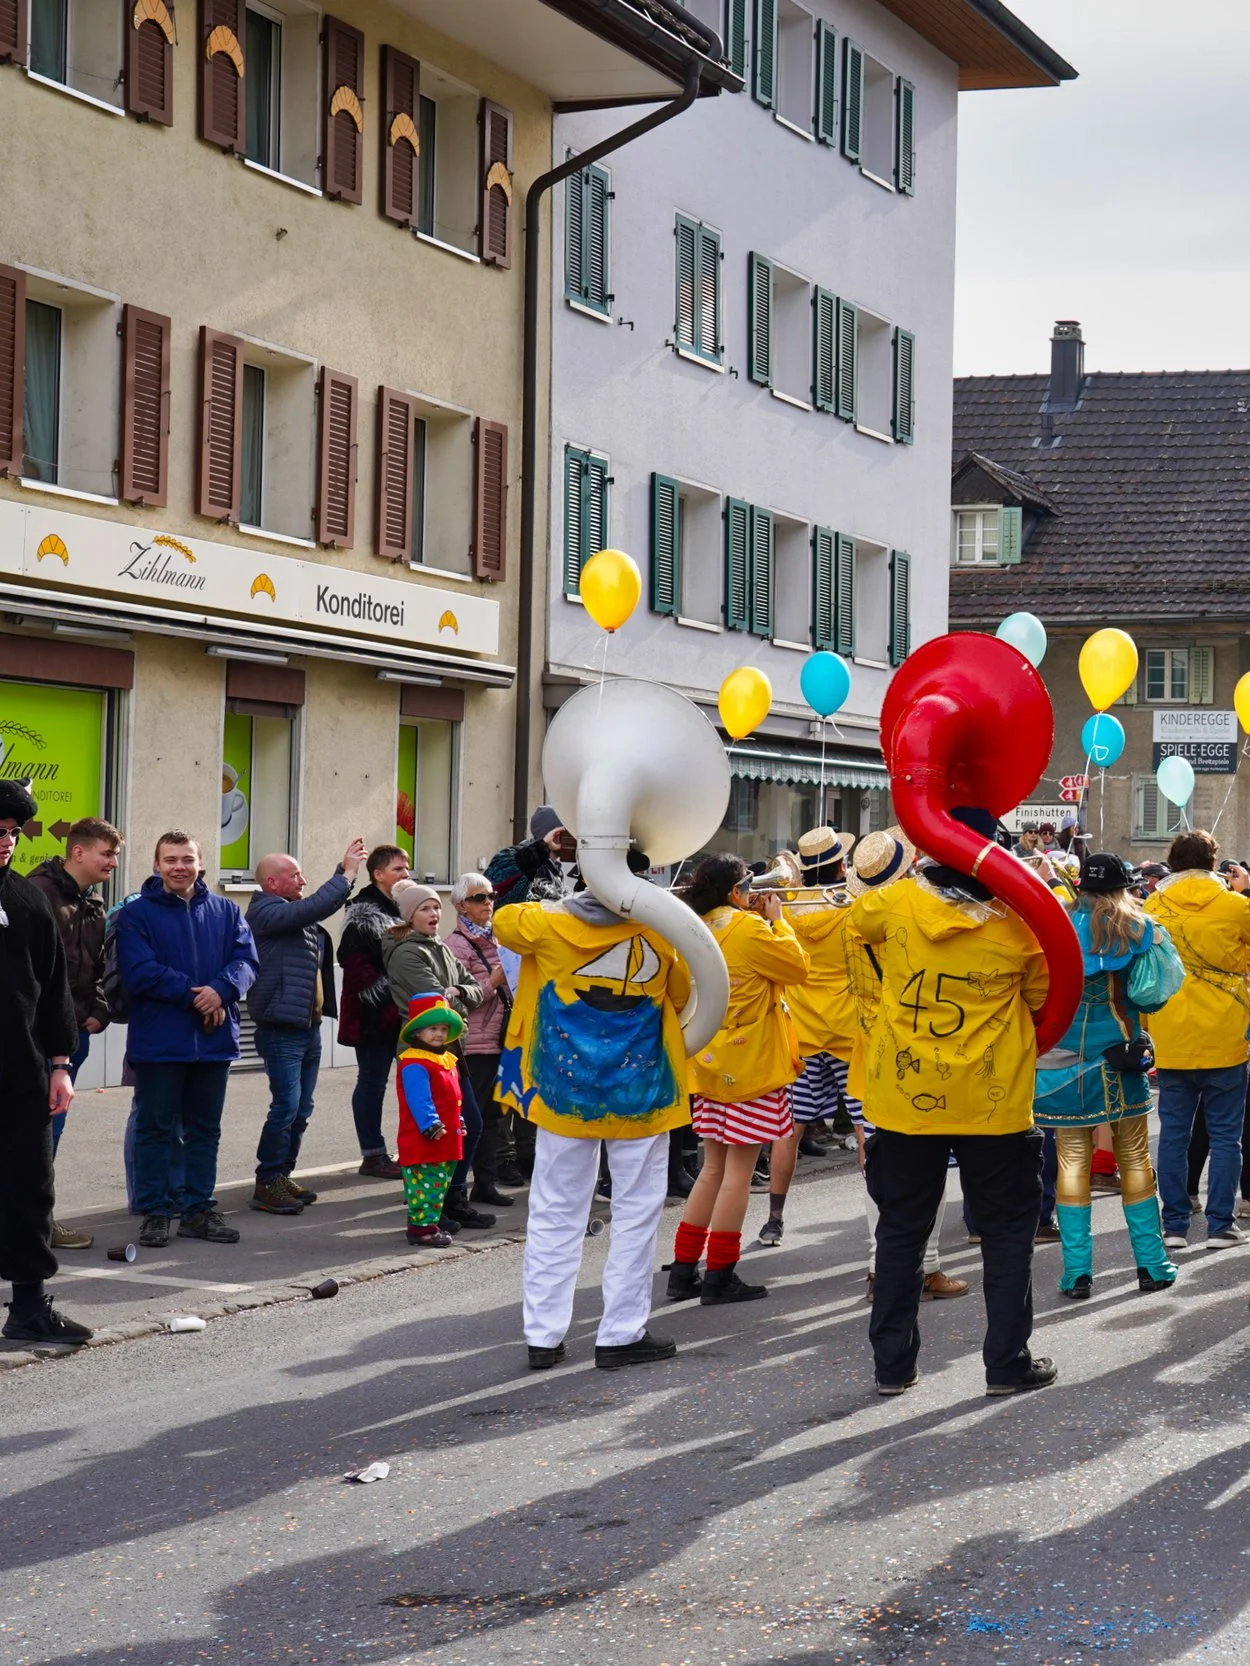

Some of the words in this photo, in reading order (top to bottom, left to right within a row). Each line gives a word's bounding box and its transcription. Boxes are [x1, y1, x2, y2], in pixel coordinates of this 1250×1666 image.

[117, 541, 206, 591] Zihlmann
[316, 584, 405, 627] Konditorei
[1160, 713, 1230, 726] KINDEREGGE
[0, 742, 60, 781] lmann
[33, 790, 73, 803] NDITOREI
[1016, 807, 1072, 817] Finishütten
[899, 968, 970, 1038] 45
